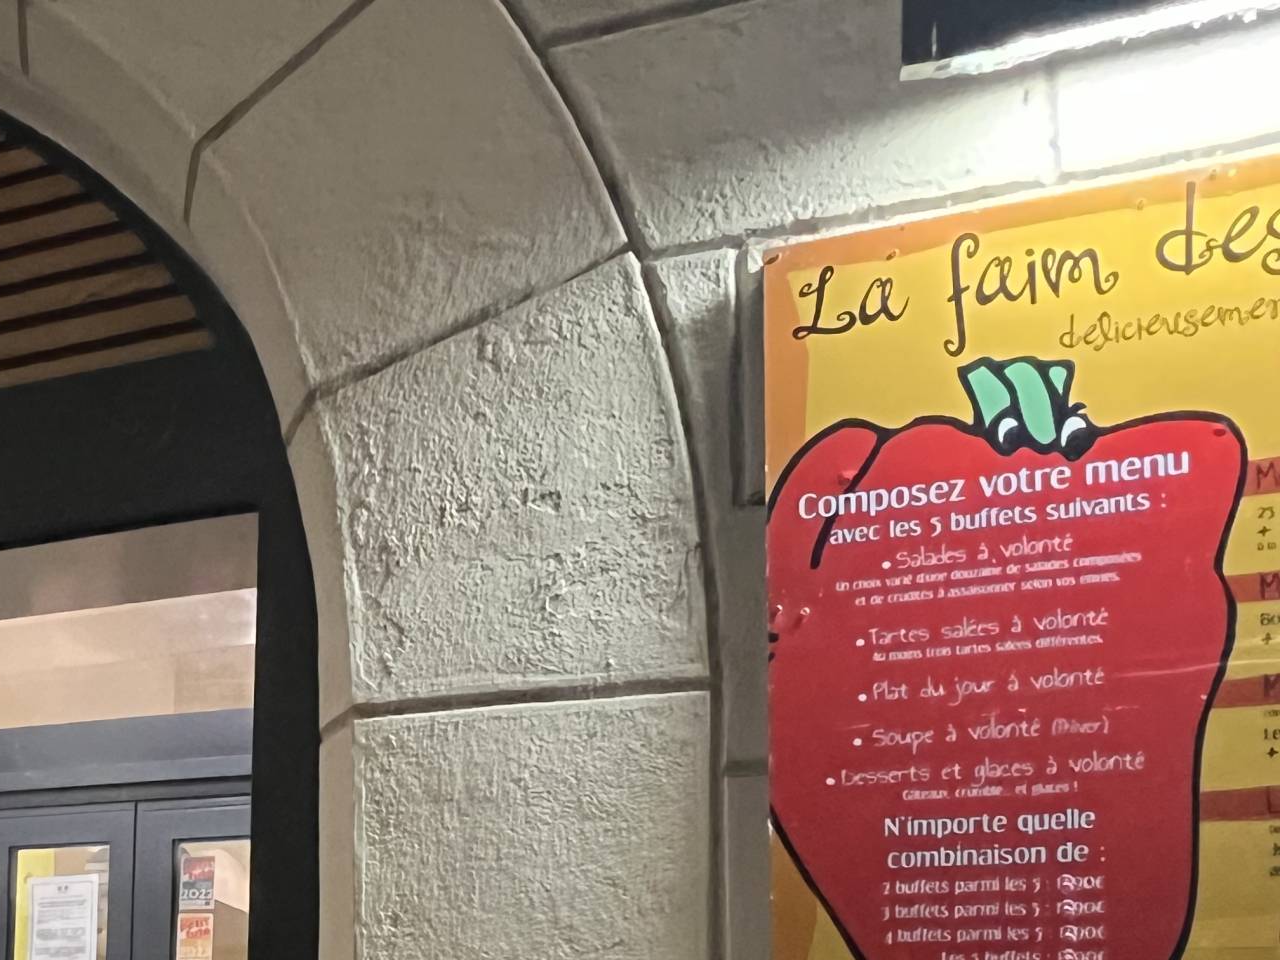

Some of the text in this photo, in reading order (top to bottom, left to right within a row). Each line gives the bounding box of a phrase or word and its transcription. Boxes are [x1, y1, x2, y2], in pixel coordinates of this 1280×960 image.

[792, 266, 910, 341] La
[943, 232, 1119, 356] faim
[799, 450, 1190, 520] Composez votre menu
[829, 492, 1151, 545] avec les 5 buffets suivants
[896, 533, 1073, 569] Salades à volonté
[868, 607, 1109, 645] Tartes salées à volonté
[872, 666, 1105, 706] Plat du jour à volonté
[872, 728, 934, 755] Soupe
[945, 723, 957, 742] à
[968, 716, 1041, 739] volonté
[840, 750, 1145, 787] Desserts et glaces à volonté
[884, 808, 1096, 838] N'importe quelle
[887, 842, 1089, 869] combinaison de
[895, 879, 949, 894] buffets
[954, 876, 1000, 896] parmi
[1005, 877, 1026, 892] les
[895, 904, 949, 919] buffets
[954, 902, 999, 919] parmi
[1005, 902, 1026, 917] les
[897, 928, 952, 943] buffets
[957, 926, 1002, 943] parmi
[1007, 926, 1029, 942] les
